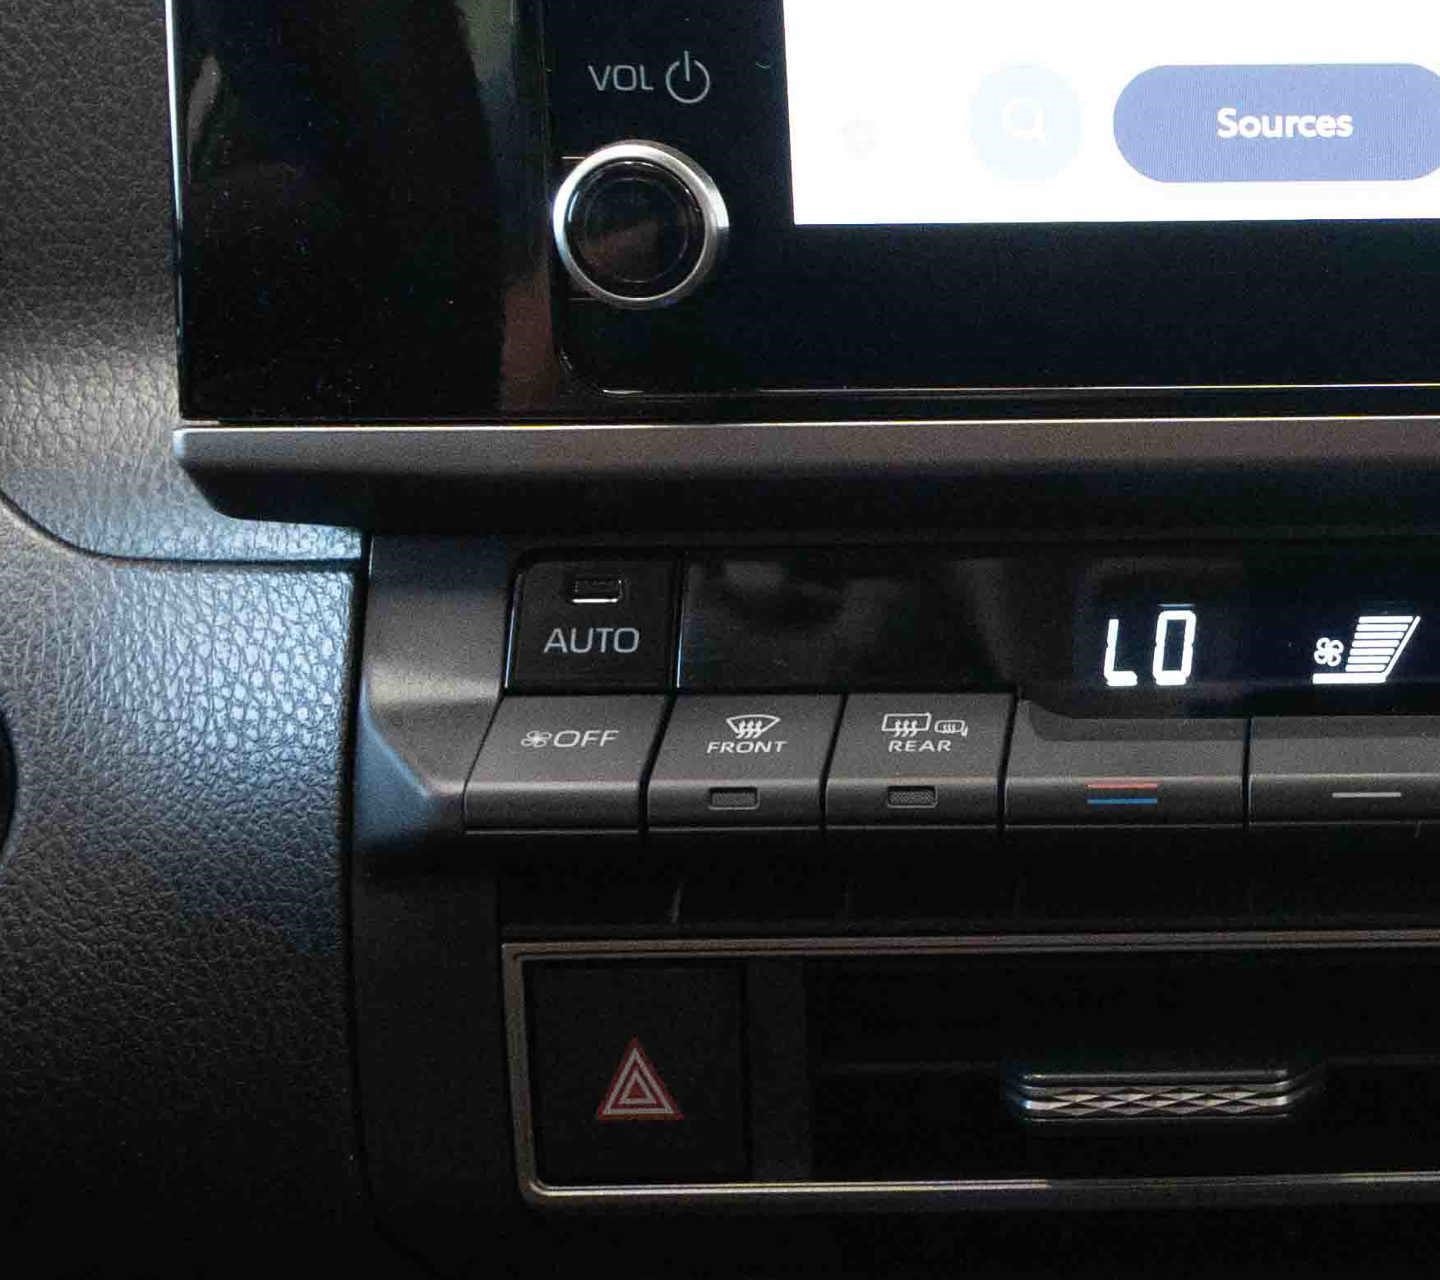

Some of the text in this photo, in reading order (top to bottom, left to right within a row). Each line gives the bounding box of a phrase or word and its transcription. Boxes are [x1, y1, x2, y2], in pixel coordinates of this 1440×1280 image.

[587, 63, 654, 92] VOL
[1215, 107, 1355, 140] Sources
[544, 626, 640, 655] AUTO
[1103, 607, 1198, 688] LO
[552, 727, 621, 750] OFF
[706, 738, 789, 754] FRONT
[887, 738, 953, 754] REAR
